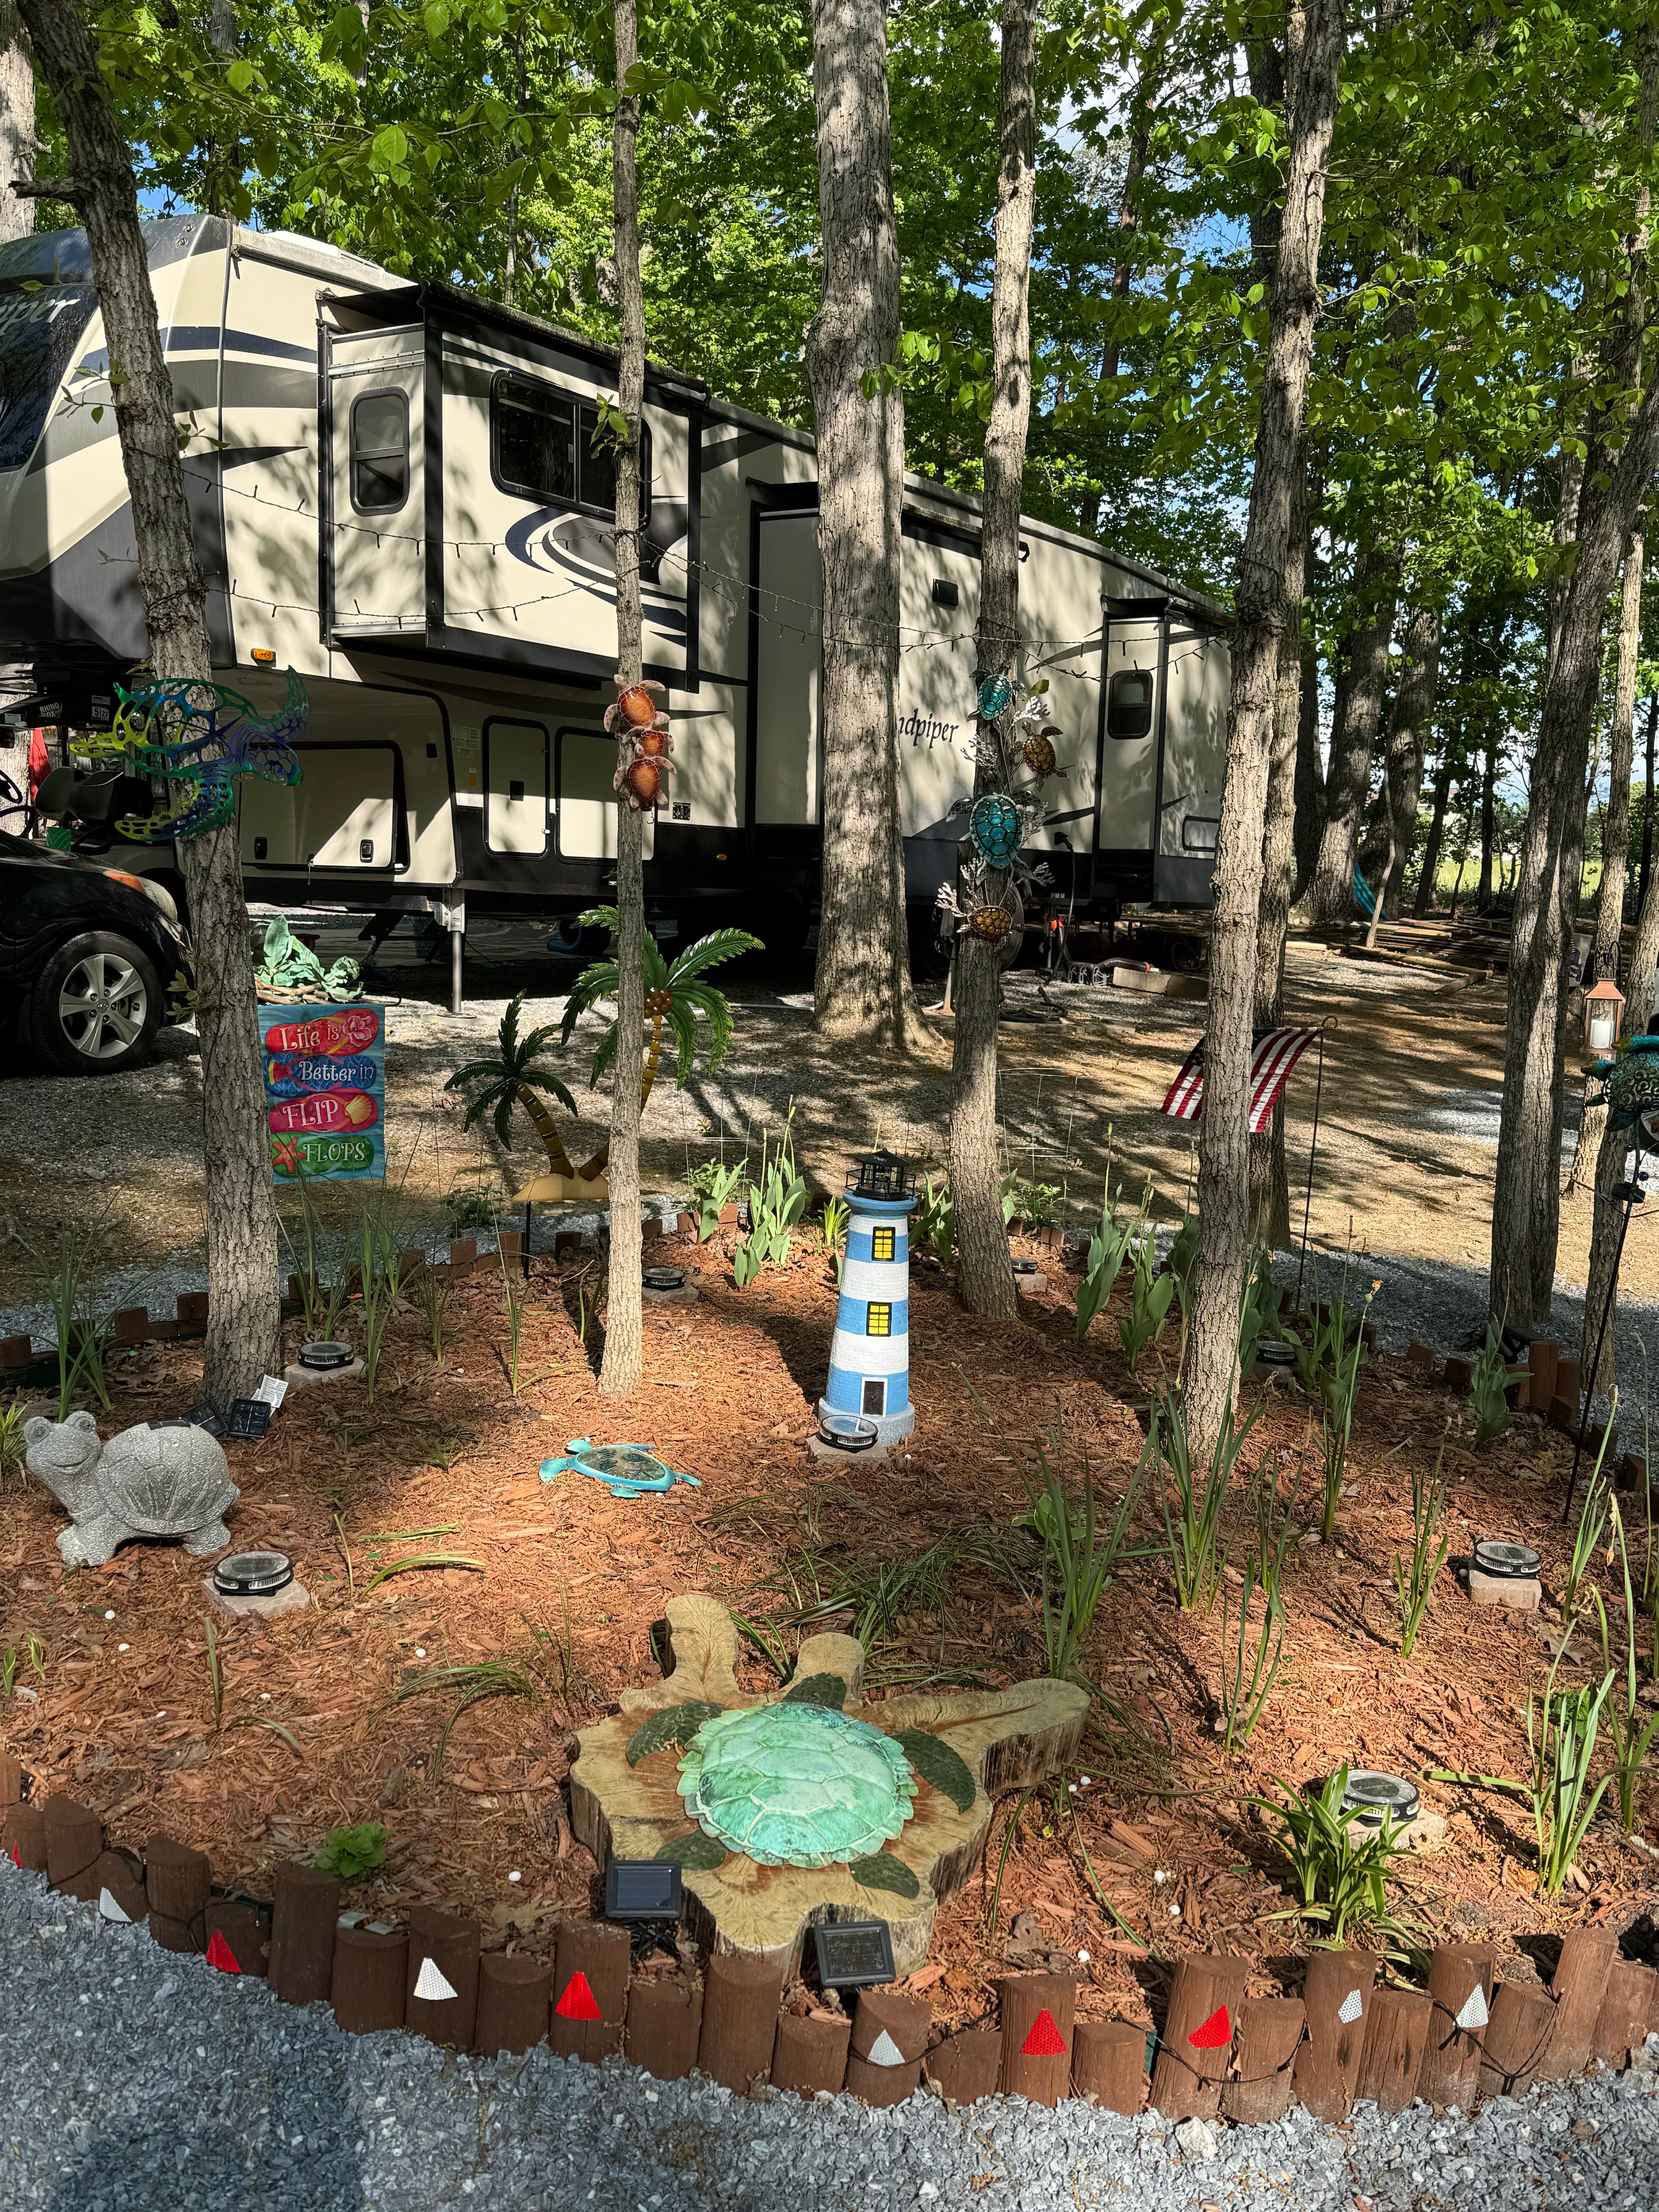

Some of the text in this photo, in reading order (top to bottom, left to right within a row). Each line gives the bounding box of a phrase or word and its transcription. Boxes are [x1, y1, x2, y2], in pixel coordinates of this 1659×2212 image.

[39, 702, 59, 713] RHINO
[94, 708, 99, 716] 5
[280, 1024, 340, 1051] Life is
[299, 1061, 374, 1082] Better in
[282, 1099, 338, 1128] FLIP
[303, 1142, 365, 1163] FLOPS
